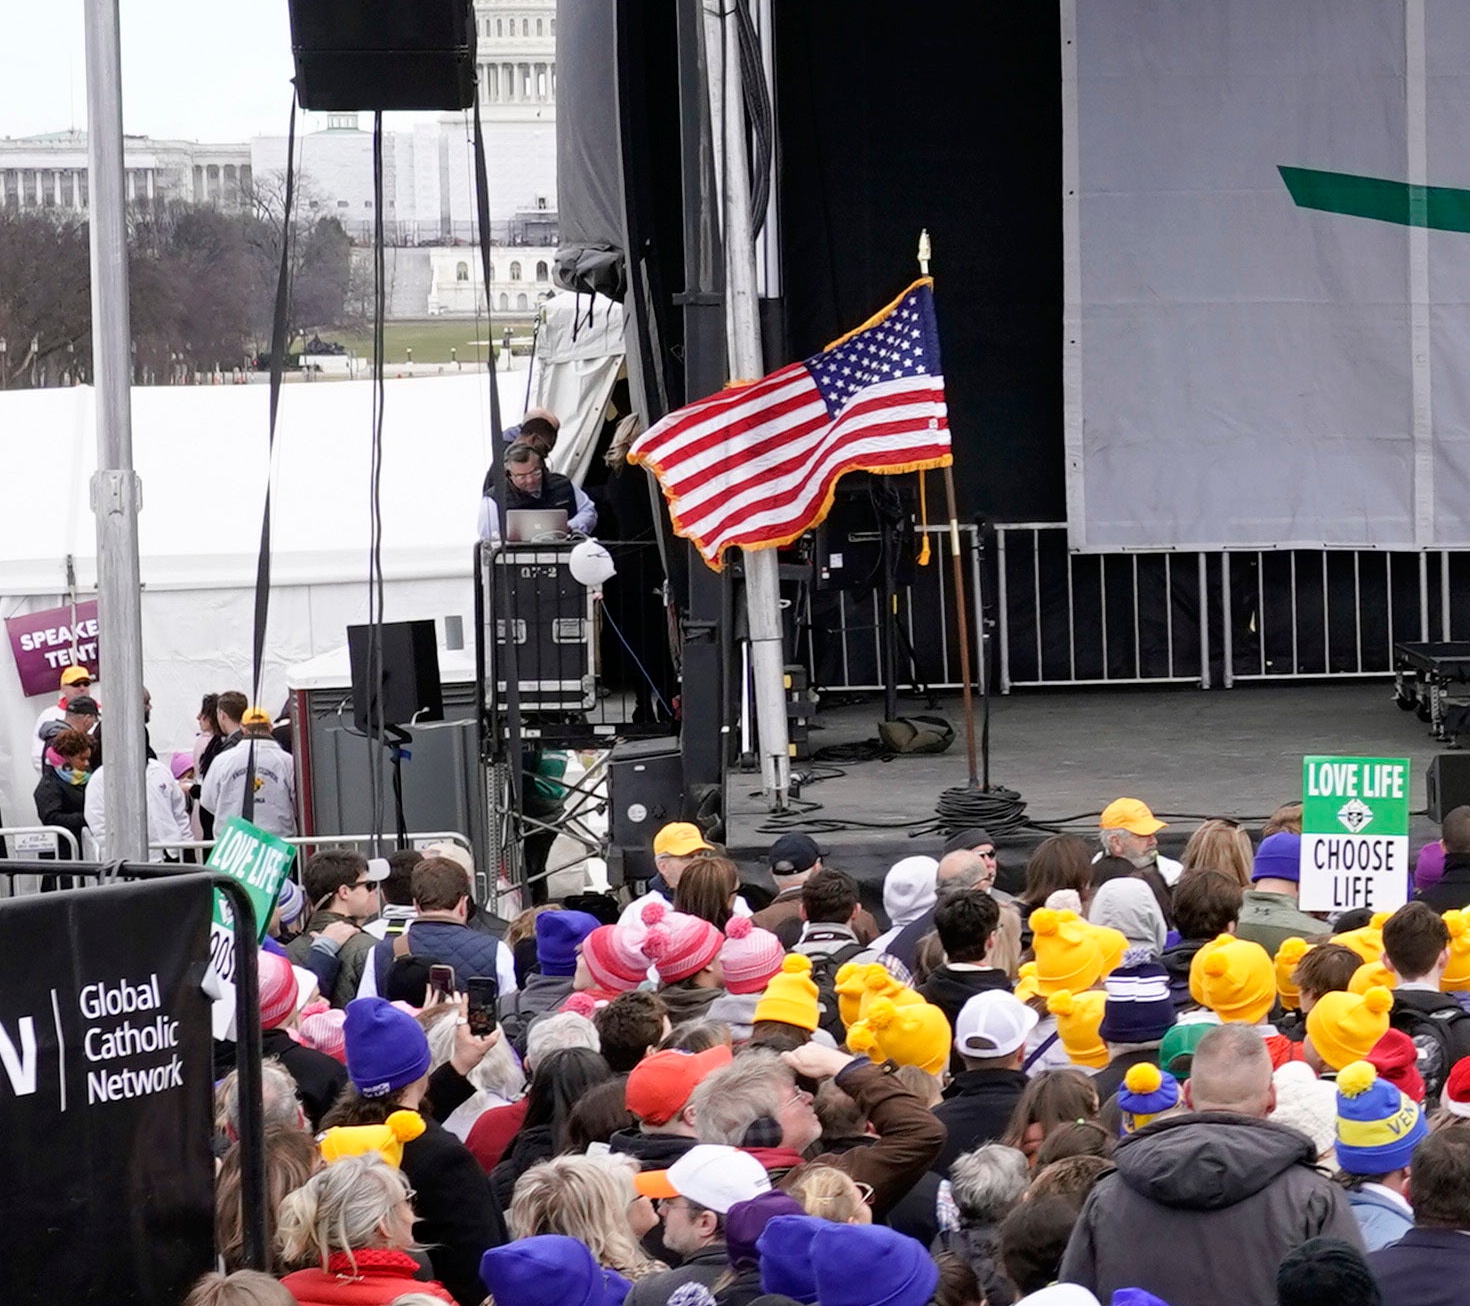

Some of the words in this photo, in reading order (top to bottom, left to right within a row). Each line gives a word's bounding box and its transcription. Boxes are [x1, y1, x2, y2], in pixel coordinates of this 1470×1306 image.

[20, 618, 99, 652] SPEAKE
[1308, 762, 1358, 798] LOVE
[1363, 763, 1404, 799] LIFE
[211, 824, 259, 880] LOVE
[1314, 838, 1395, 871] CHOOSE
[1333, 876, 1374, 908] LIFE
[79, 973, 162, 1020] Global
[84, 1015, 179, 1062] Catholic
[87, 1053, 184, 1105] Network
